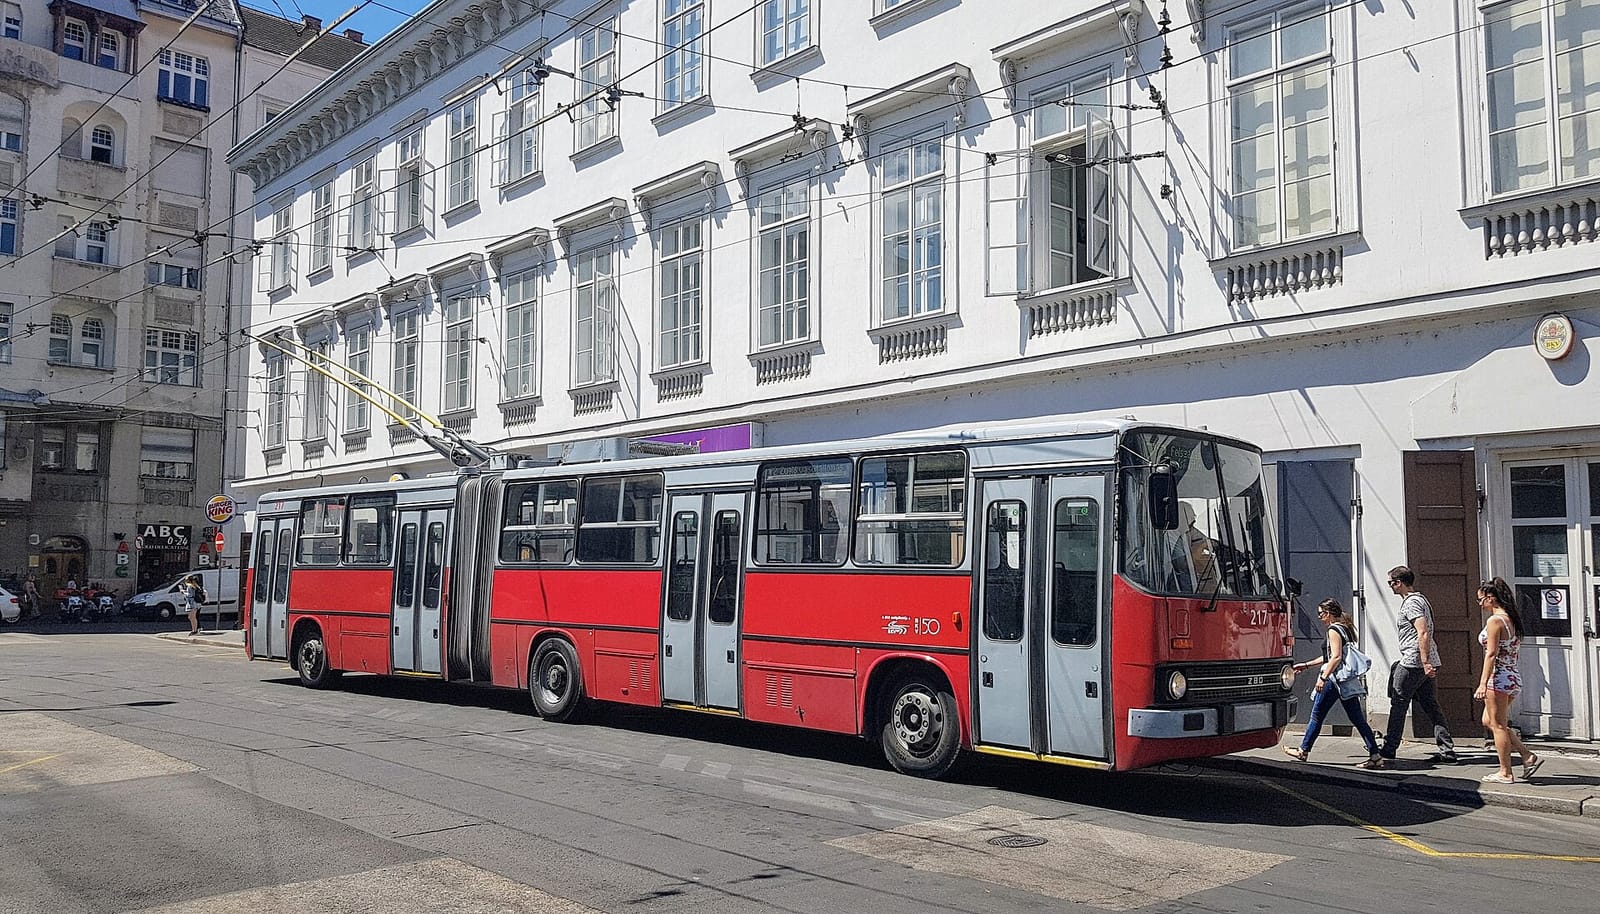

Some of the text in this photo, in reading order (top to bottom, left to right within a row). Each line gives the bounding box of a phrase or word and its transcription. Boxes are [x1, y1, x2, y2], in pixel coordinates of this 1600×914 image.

[208, 501, 232, 510] BURGER
[208, 507, 232, 517] KING
[143, 525, 185, 538] ABC
[1250, 609, 1268, 625] 217
[922, 618, 940, 635] 50
